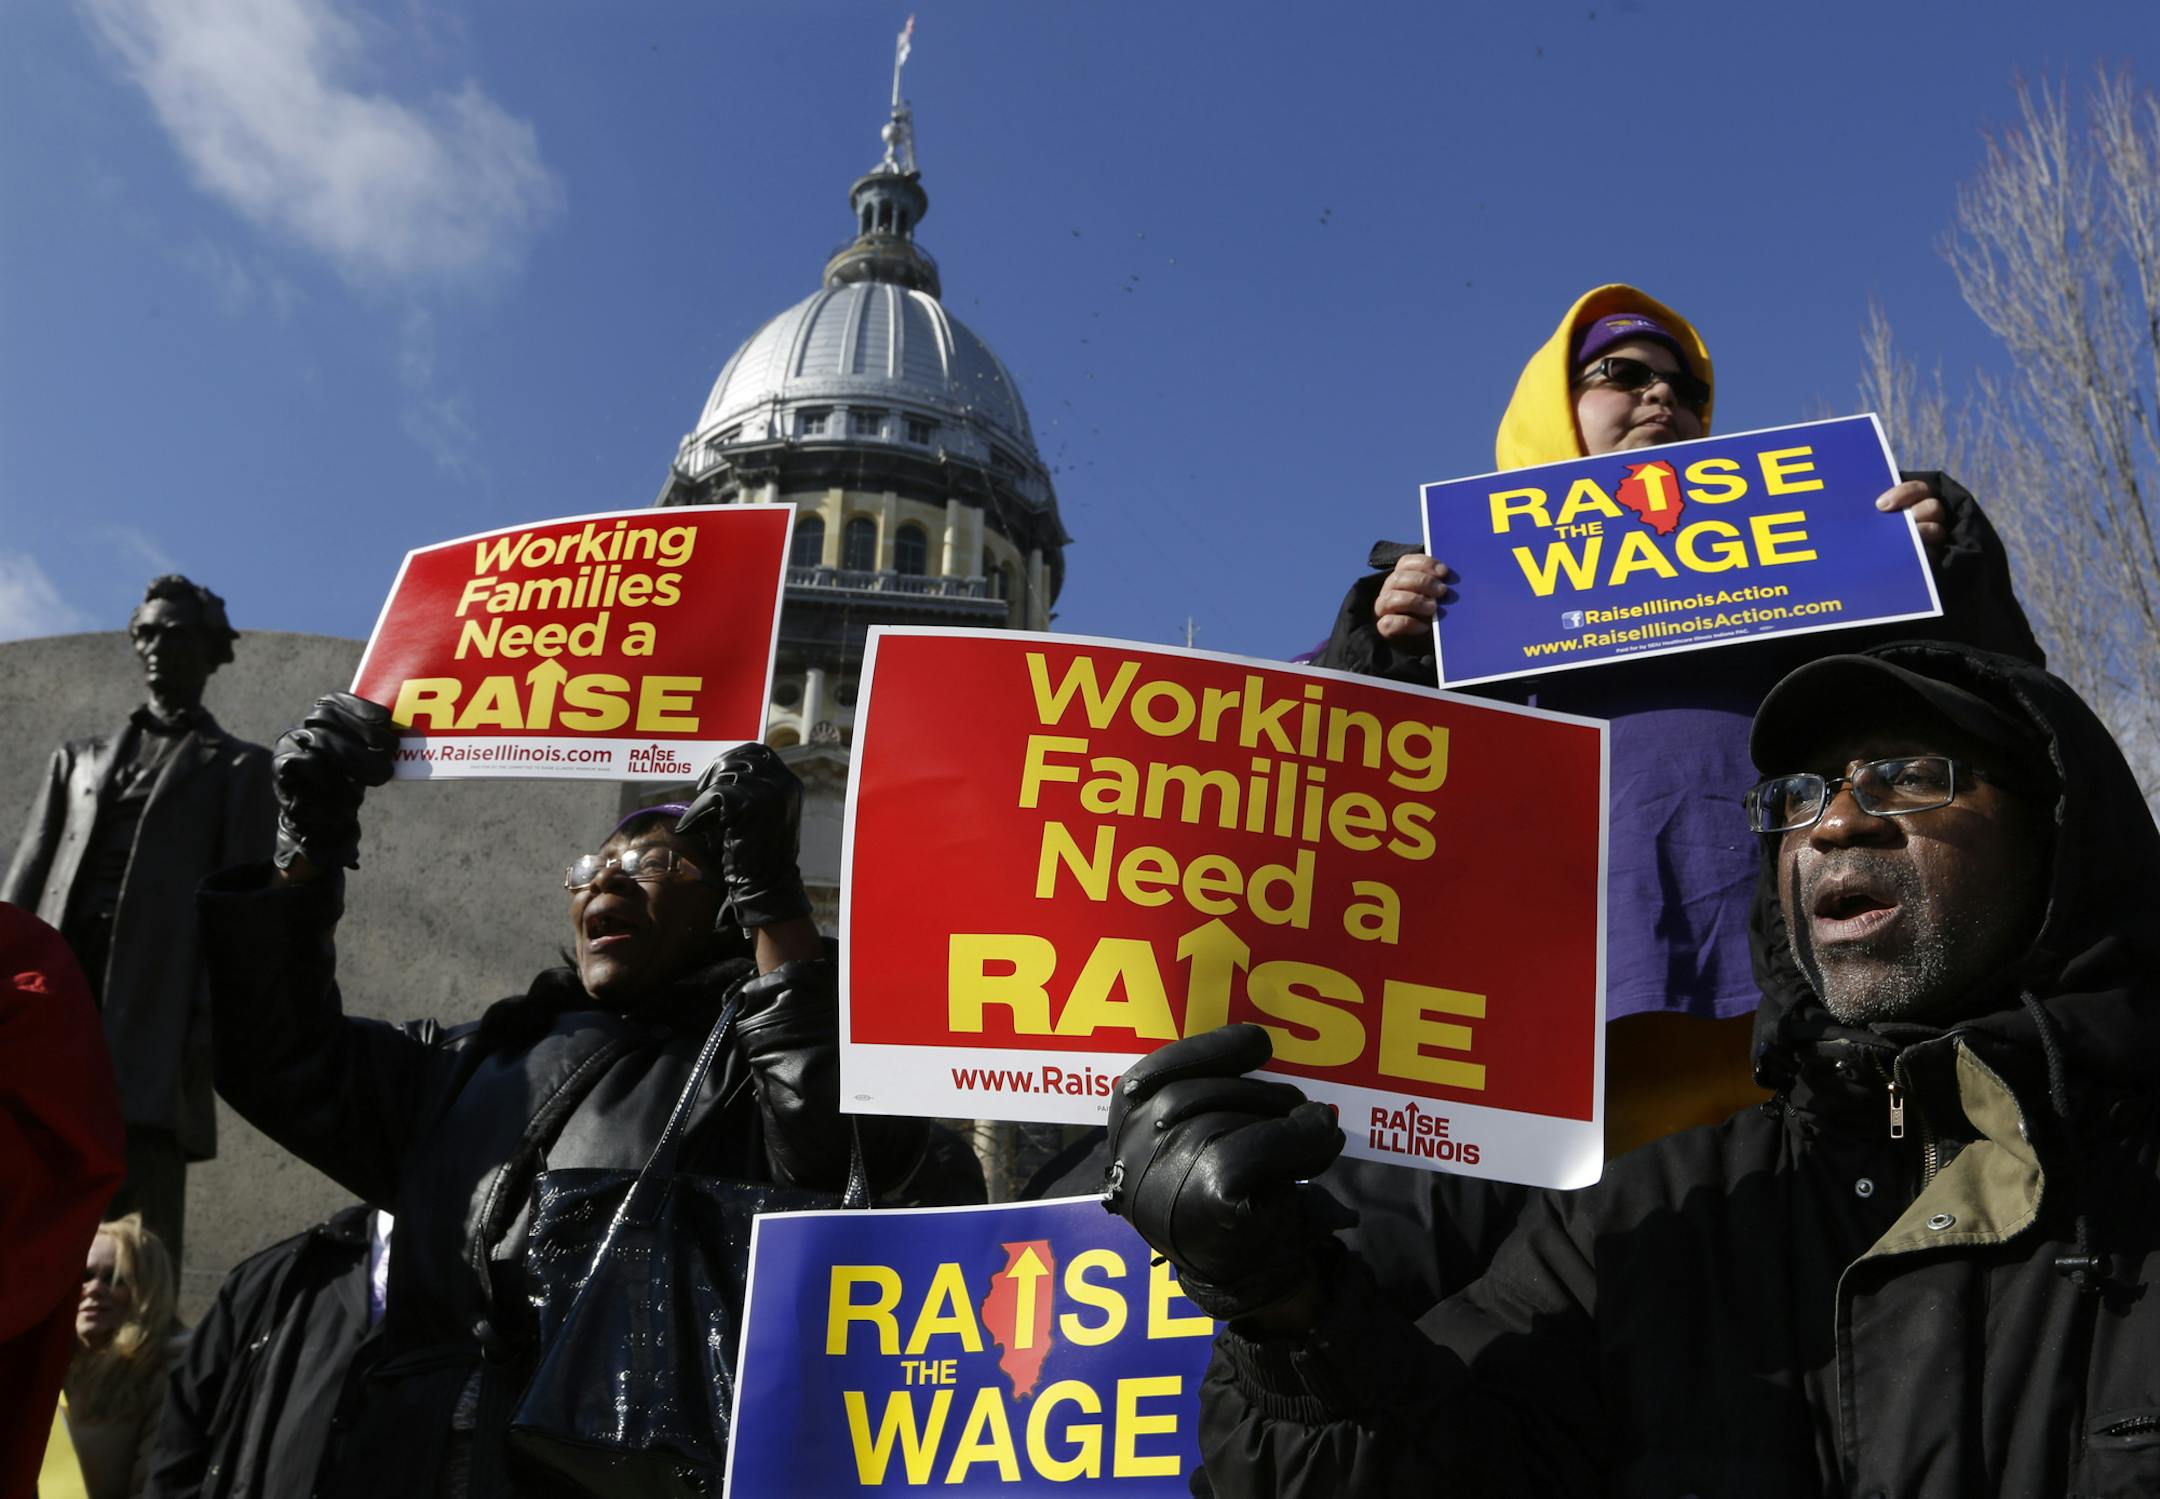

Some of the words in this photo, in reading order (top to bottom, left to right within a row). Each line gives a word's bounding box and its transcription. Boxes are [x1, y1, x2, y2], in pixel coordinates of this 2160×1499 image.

[1488, 446, 1825, 534] RAISE
[475, 520, 698, 576] Working
[1512, 512, 1818, 597] WAGE
[1554, 522, 1604, 540] THE
[455, 564, 683, 617] Families
[1585, 585, 1789, 624] RaiseIllinoisAction
[455, 612, 610, 660] Need
[621, 621, 656, 657] a
[1523, 599, 1843, 657] www.RaiseIllinoisAction.com
[391, 658, 703, 733] RAISE
[1025, 652, 1450, 792] Working
[628, 761, 692, 774] ILLINOIS
[630, 744, 675, 761] RAISE
[1018, 734, 1437, 861] Families
[1035, 820, 1316, 930] Need
[1343, 880, 1401, 945] a
[947, 918, 1487, 1091] RAISE
[951, 1066, 1121, 1097] www.Rais
[1369, 1128, 1481, 1165] ILLINOIS
[1370, 1102, 1450, 1139] RAISE
[826, 1246, 1214, 1356] RAISE
[901, 1359, 958, 1385] THE
[843, 1375, 1183, 1486] WAGE
